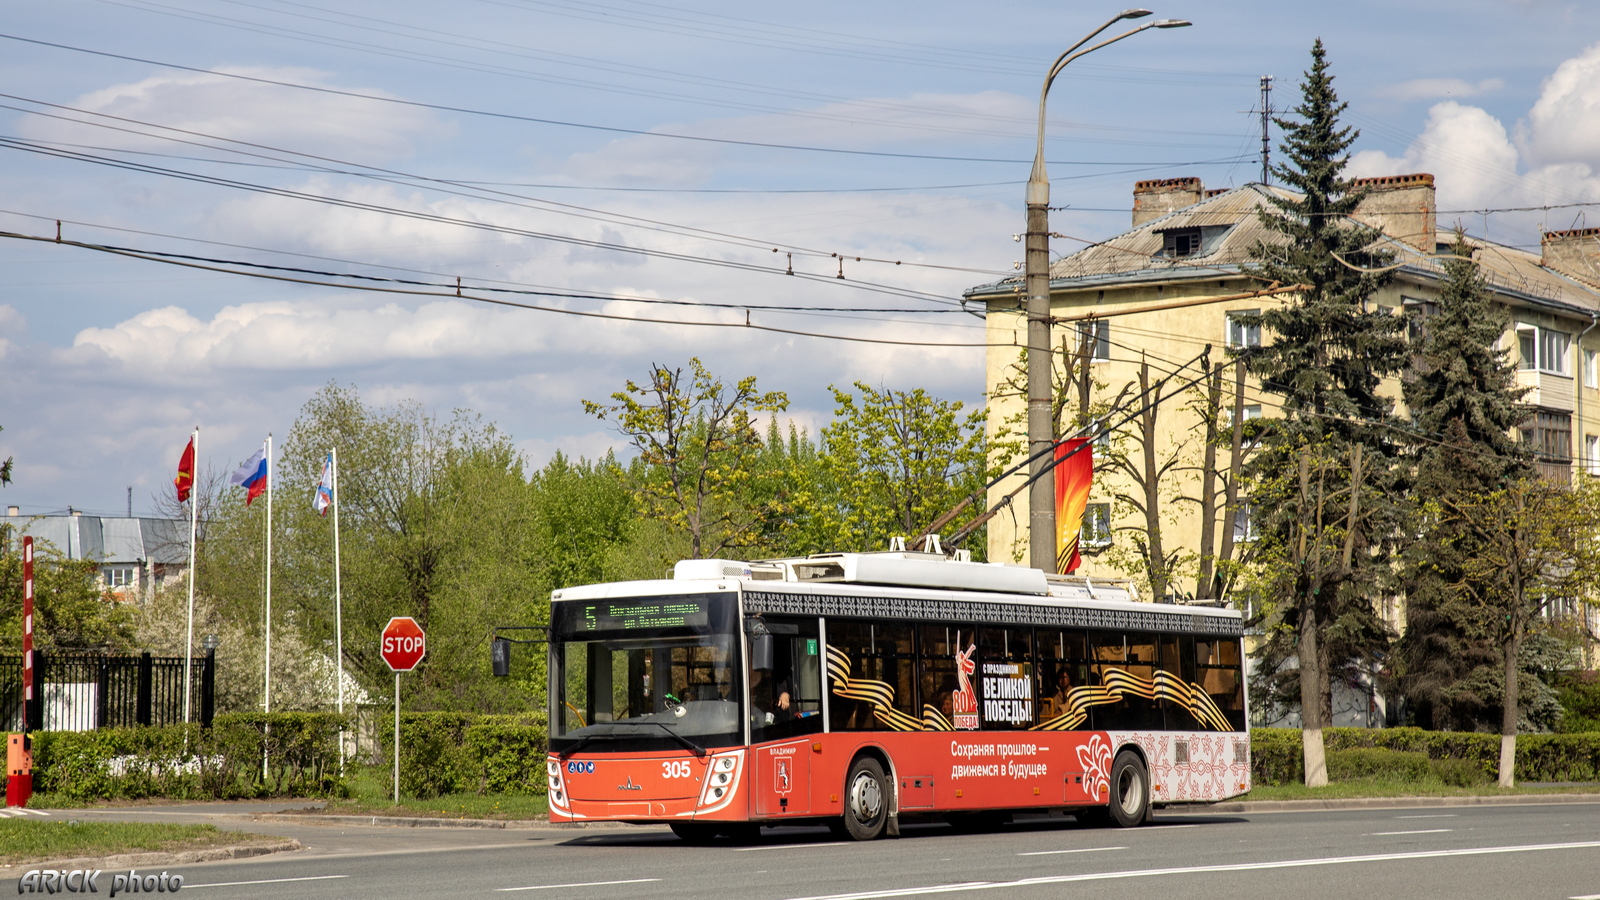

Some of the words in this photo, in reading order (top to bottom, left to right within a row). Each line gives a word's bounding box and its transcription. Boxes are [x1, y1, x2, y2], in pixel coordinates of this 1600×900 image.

[586, 606, 596, 630] 5
[610, 605, 660, 617] Вокзальная
[384, 637, 423, 653] STOP
[988, 664, 1018, 675] ПРАЗДНИКОМ
[983, 675, 1031, 699] ВЕЛИКОЙ
[953, 690, 969, 712] 80
[984, 700, 1032, 725] ПОБЕДЫ!
[955, 716, 979, 730] ПОБЕДА!
[770, 747, 796, 756] ВЛАДИМИР
[951, 741, 995, 760] Сохраняя
[997, 744, 1036, 759] прошлое
[662, 761, 690, 778] 305
[951, 764, 998, 780] движемся
[1001, 765, 1006, 775] в
[1008, 760, 1047, 779] будущее
